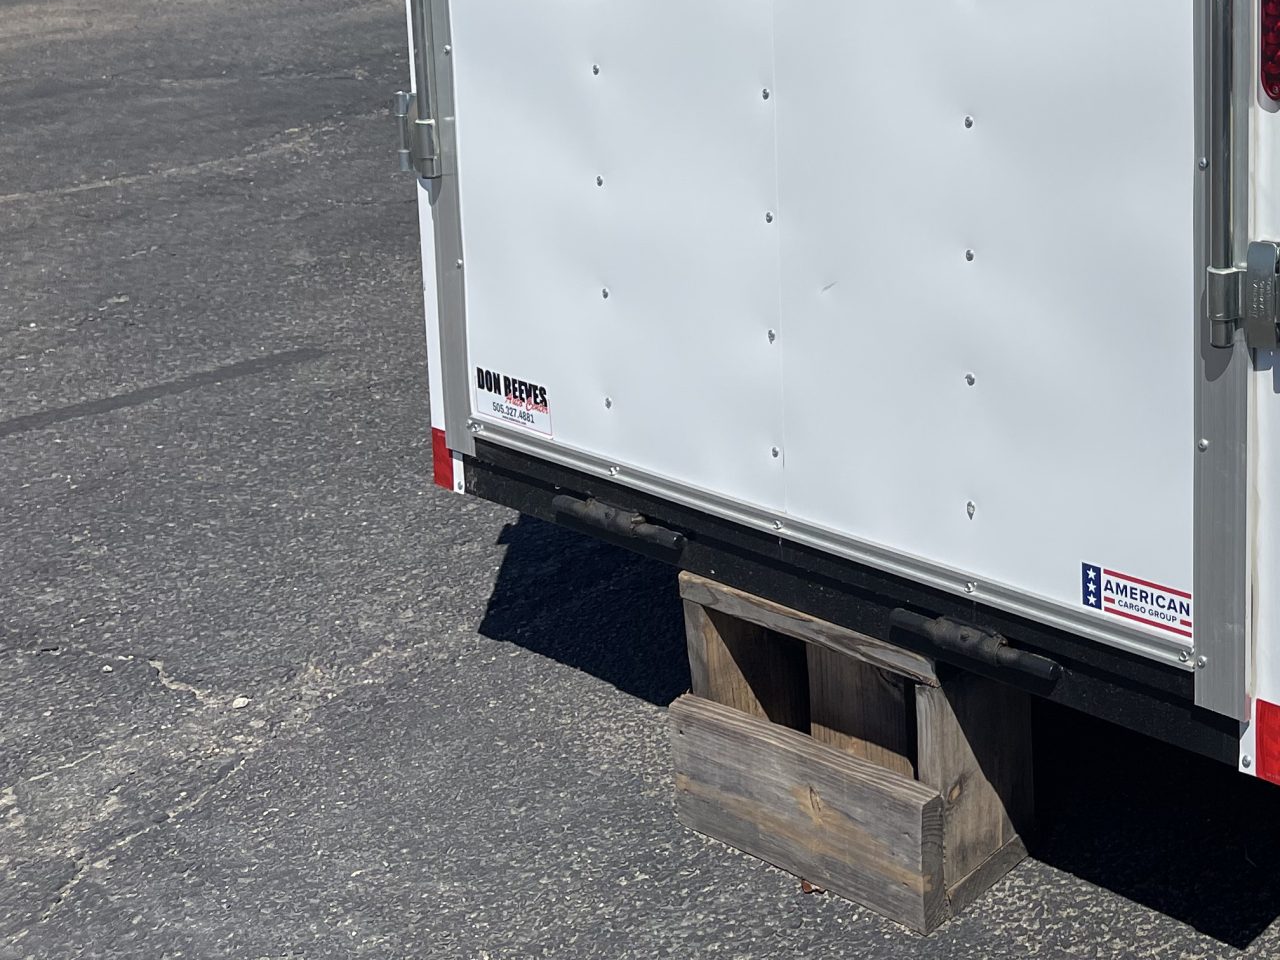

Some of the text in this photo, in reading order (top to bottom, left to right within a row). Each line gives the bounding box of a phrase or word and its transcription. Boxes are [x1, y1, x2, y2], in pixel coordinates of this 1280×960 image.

[476, 366, 548, 407] DON REEVES
[1103, 579, 1190, 616] AMERICAN
[1118, 599, 1177, 623] CARGO GROUP
